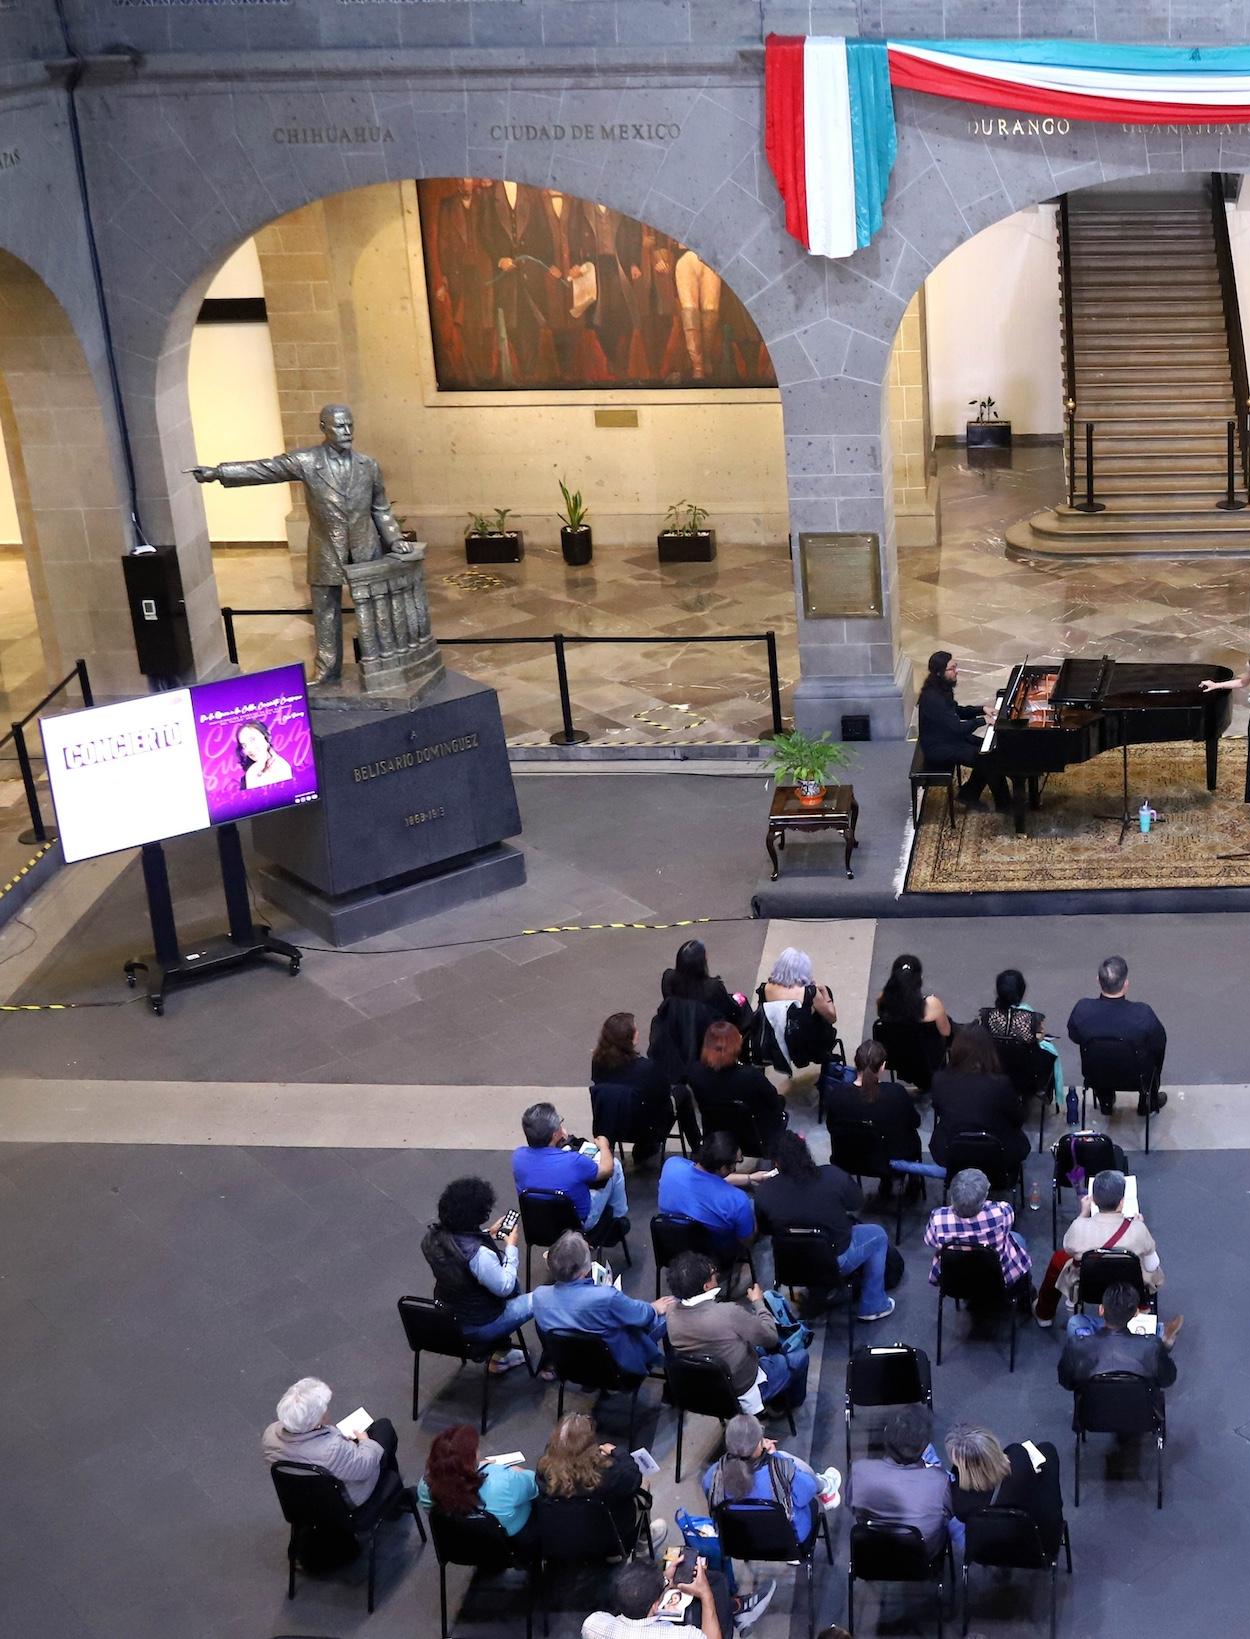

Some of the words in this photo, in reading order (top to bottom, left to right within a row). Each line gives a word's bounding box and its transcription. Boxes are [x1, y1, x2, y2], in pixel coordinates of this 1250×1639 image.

[272, 126, 396, 144] CHIHUAHUA
[490, 124, 566, 141] CIUDAD
[571, 124, 595, 140] DE
[601, 123, 681, 140] MEXICO
[968, 118, 1070, 136] DURANGO
[63, 721, 182, 770] CONCIERTO
[353, 752, 414, 783] BELISARIO
[416, 733, 479, 763] DOMINGUEZ
